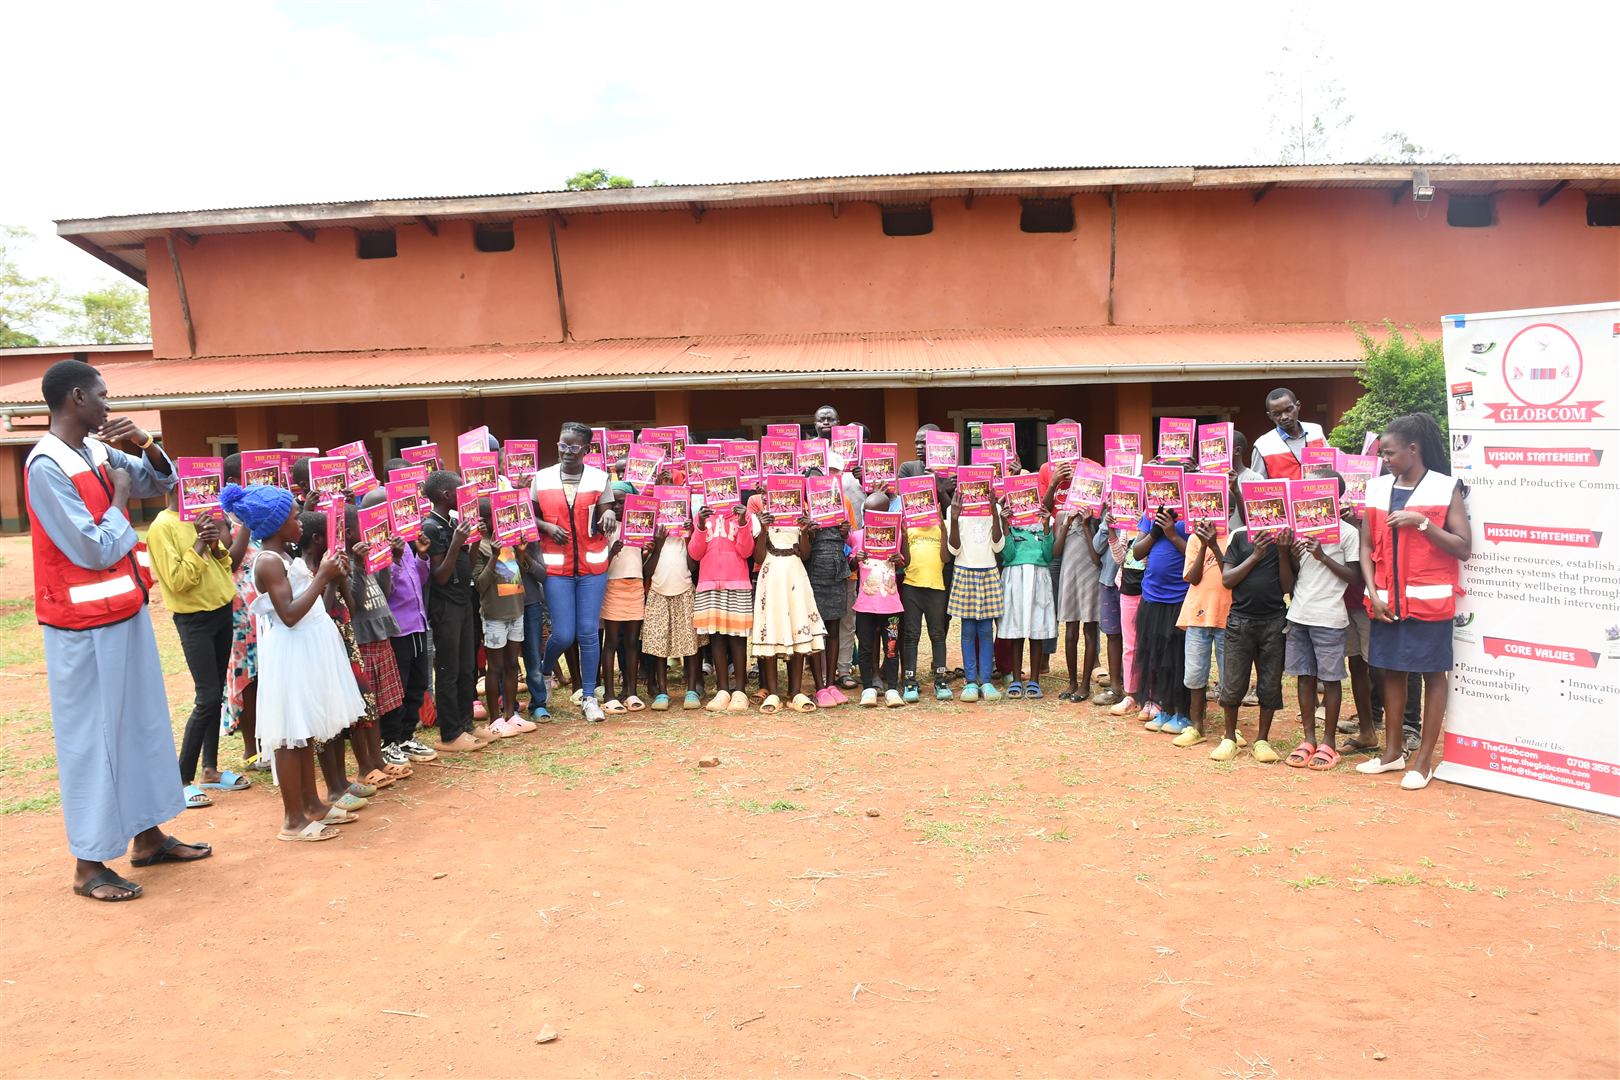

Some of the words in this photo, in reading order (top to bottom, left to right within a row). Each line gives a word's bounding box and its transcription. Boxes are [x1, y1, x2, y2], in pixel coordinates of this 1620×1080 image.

[1500, 408, 1586, 421] GLOBCOM
[1488, 451, 1524, 461] VISION
[1527, 452, 1590, 462] STATEMENT
[1498, 478, 1516, 486] and
[1520, 478, 1575, 488] Productive
[1488, 528, 1527, 539] MISSION
[1530, 530, 1591, 543] STATEMENT
[1514, 556, 1563, 568] resources,
[1567, 559, 1615, 570] establish
[1464, 564, 1513, 576] strengthen
[1516, 568, 1556, 579] systems
[1559, 571, 1579, 581] that
[1583, 575, 1620, 585] promo
[1467, 577, 1521, 590] community
[1524, 581, 1577, 595] wellbeing
[1465, 586, 1494, 598] idence
[1497, 591, 1525, 601] based
[1529, 594, 1561, 605] health
[1504, 644, 1532, 656] CORE
[1535, 648, 1575, 661] VALUES
[1460, 662, 1515, 680] Partnership
[1460, 675, 1530, 694] Accountability
[1460, 687, 1510, 702] Teamwork
[1568, 691, 1604, 704] Justice
[1482, 741, 1538, 758] TheGlobcom
[1515, 736, 1547, 749] Contact
[1500, 755, 1590, 779] www.theglobcom.com
[1567, 757, 1590, 770] 0708
[1502, 764, 1590, 790] info@theglobcom.org
